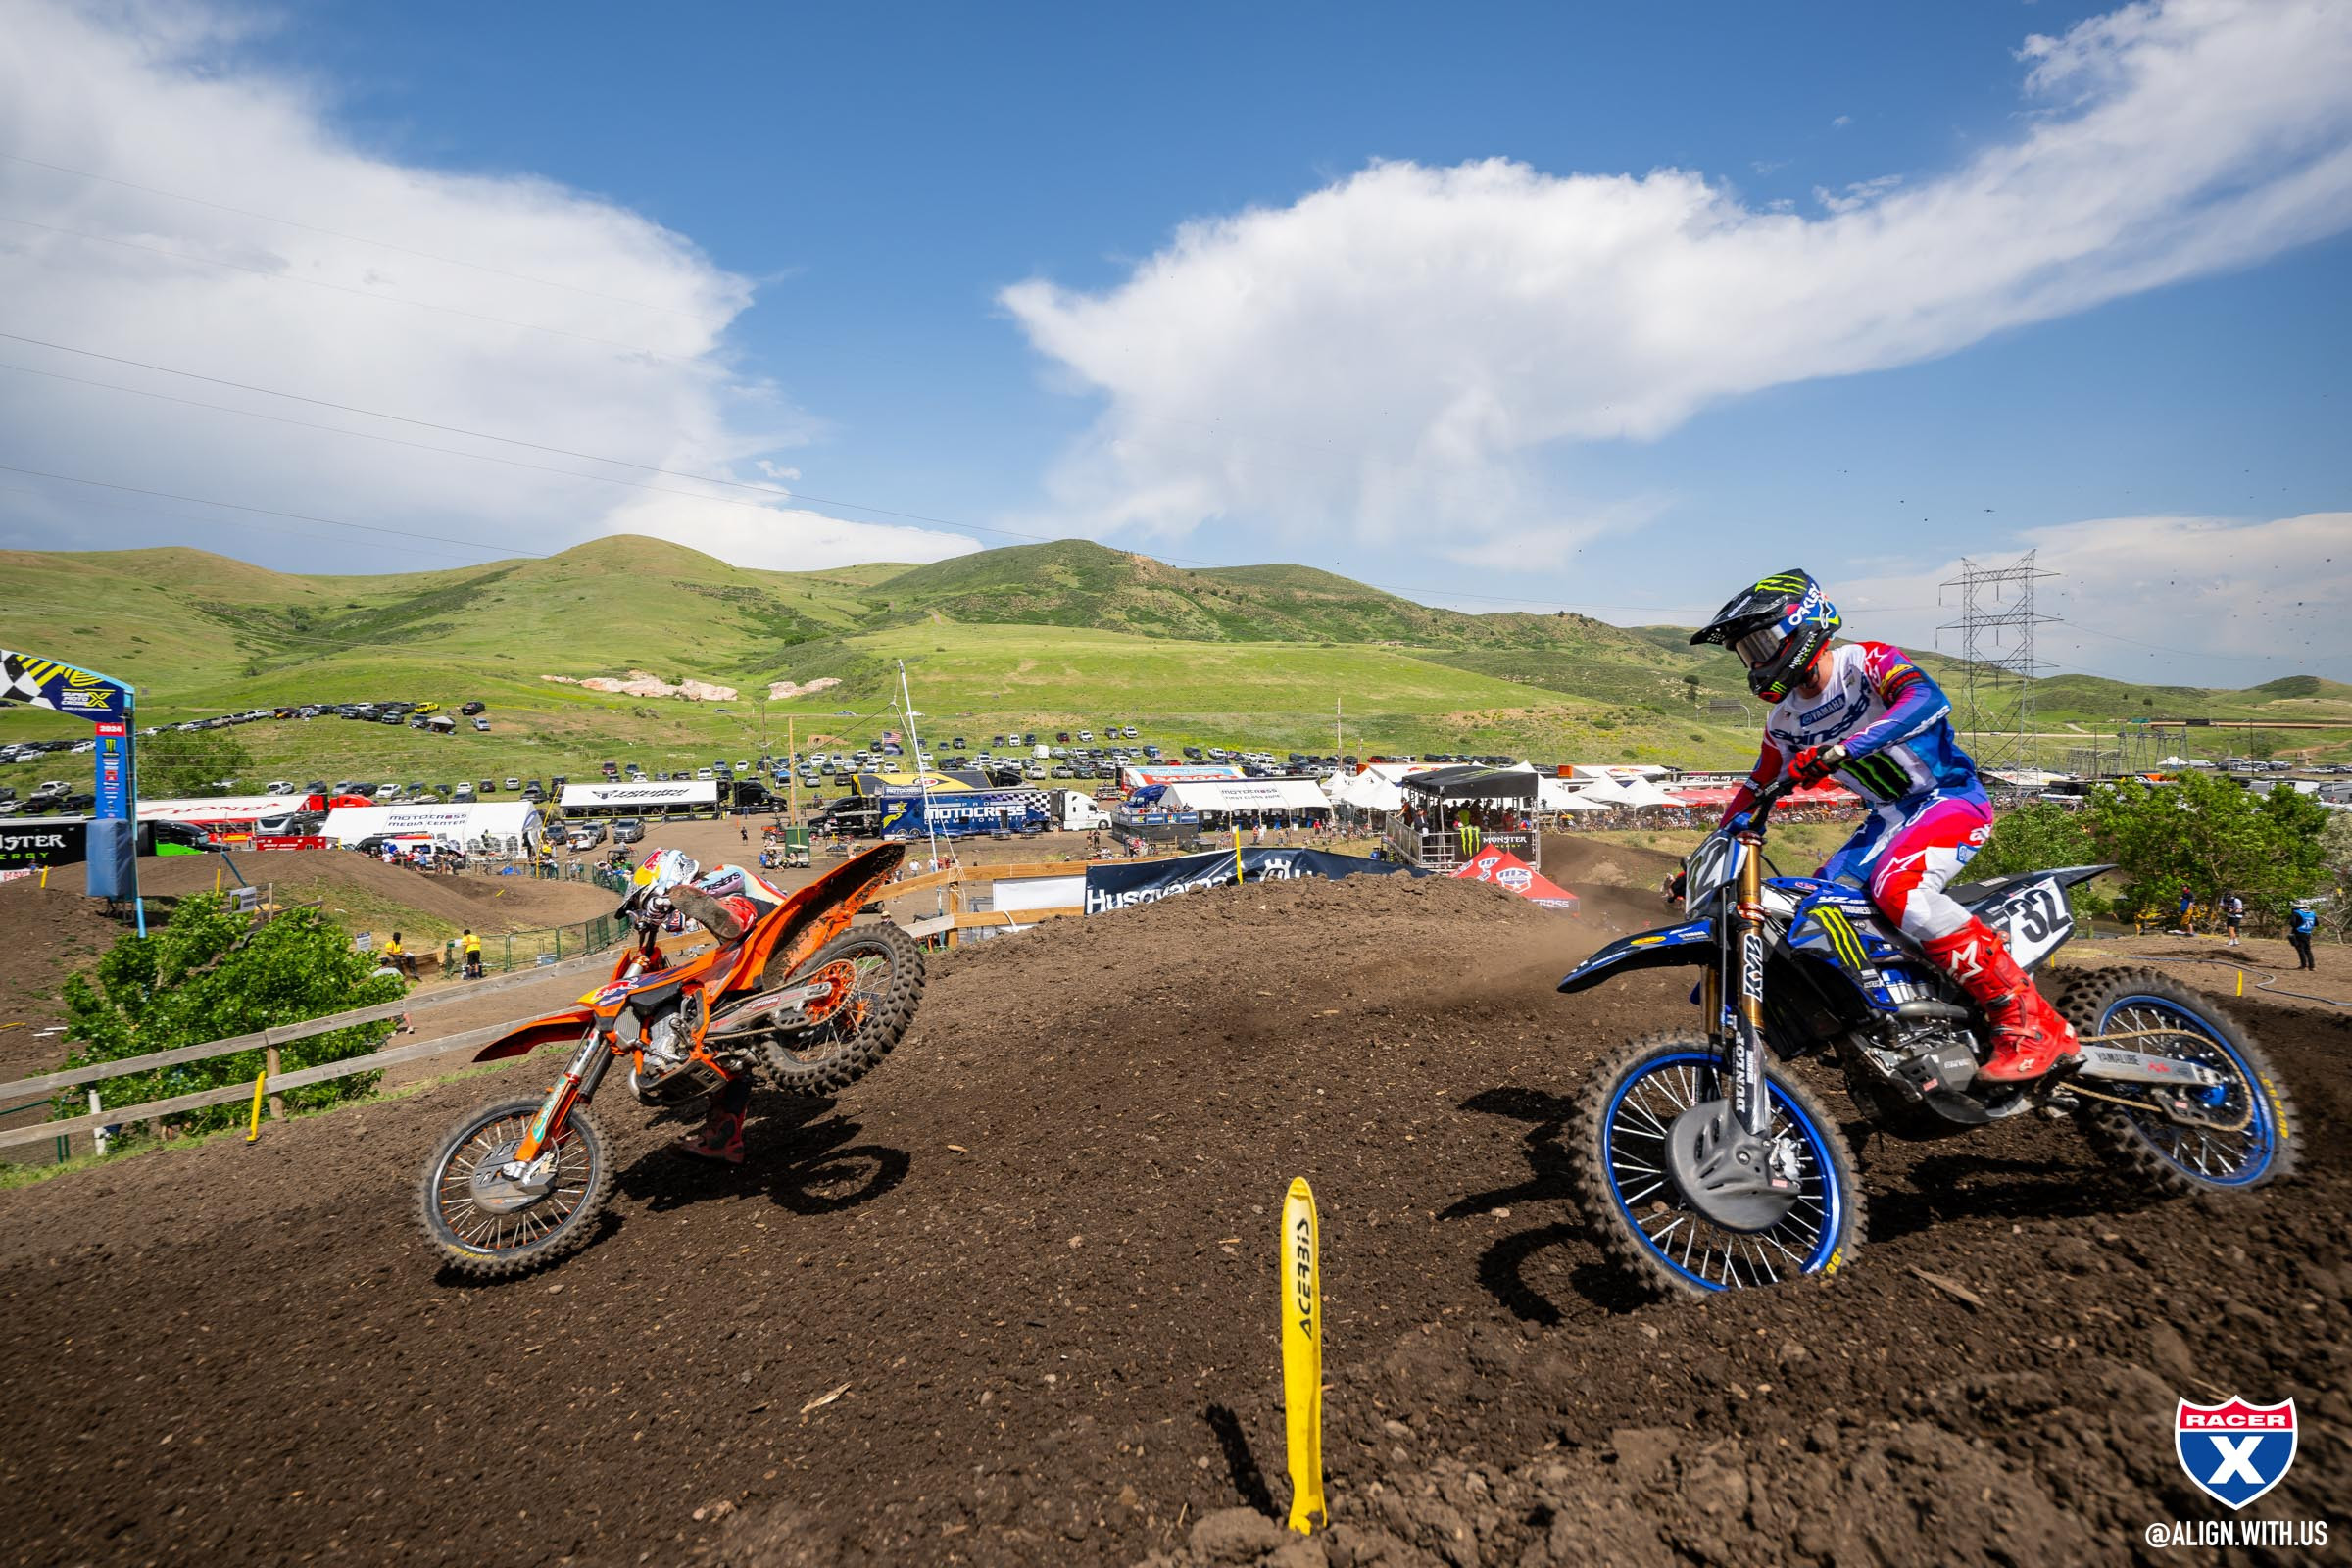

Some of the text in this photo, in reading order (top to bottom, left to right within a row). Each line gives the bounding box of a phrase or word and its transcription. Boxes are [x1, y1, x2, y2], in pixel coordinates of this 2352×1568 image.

[1788, 583, 1821, 625] OAKLEY
[1811, 697, 1845, 720] YAMAHA
[171, 803, 281, 814] HONDA
[0, 835, 67, 851] STER
[1482, 835, 1527, 844] MONSTER
[2002, 888, 2073, 943] 32
[1743, 933, 1763, 1004] KYB
[2095, 1052, 2140, 1065] YAMALUBE
[1736, 1031, 1746, 1113] DUNLOP
